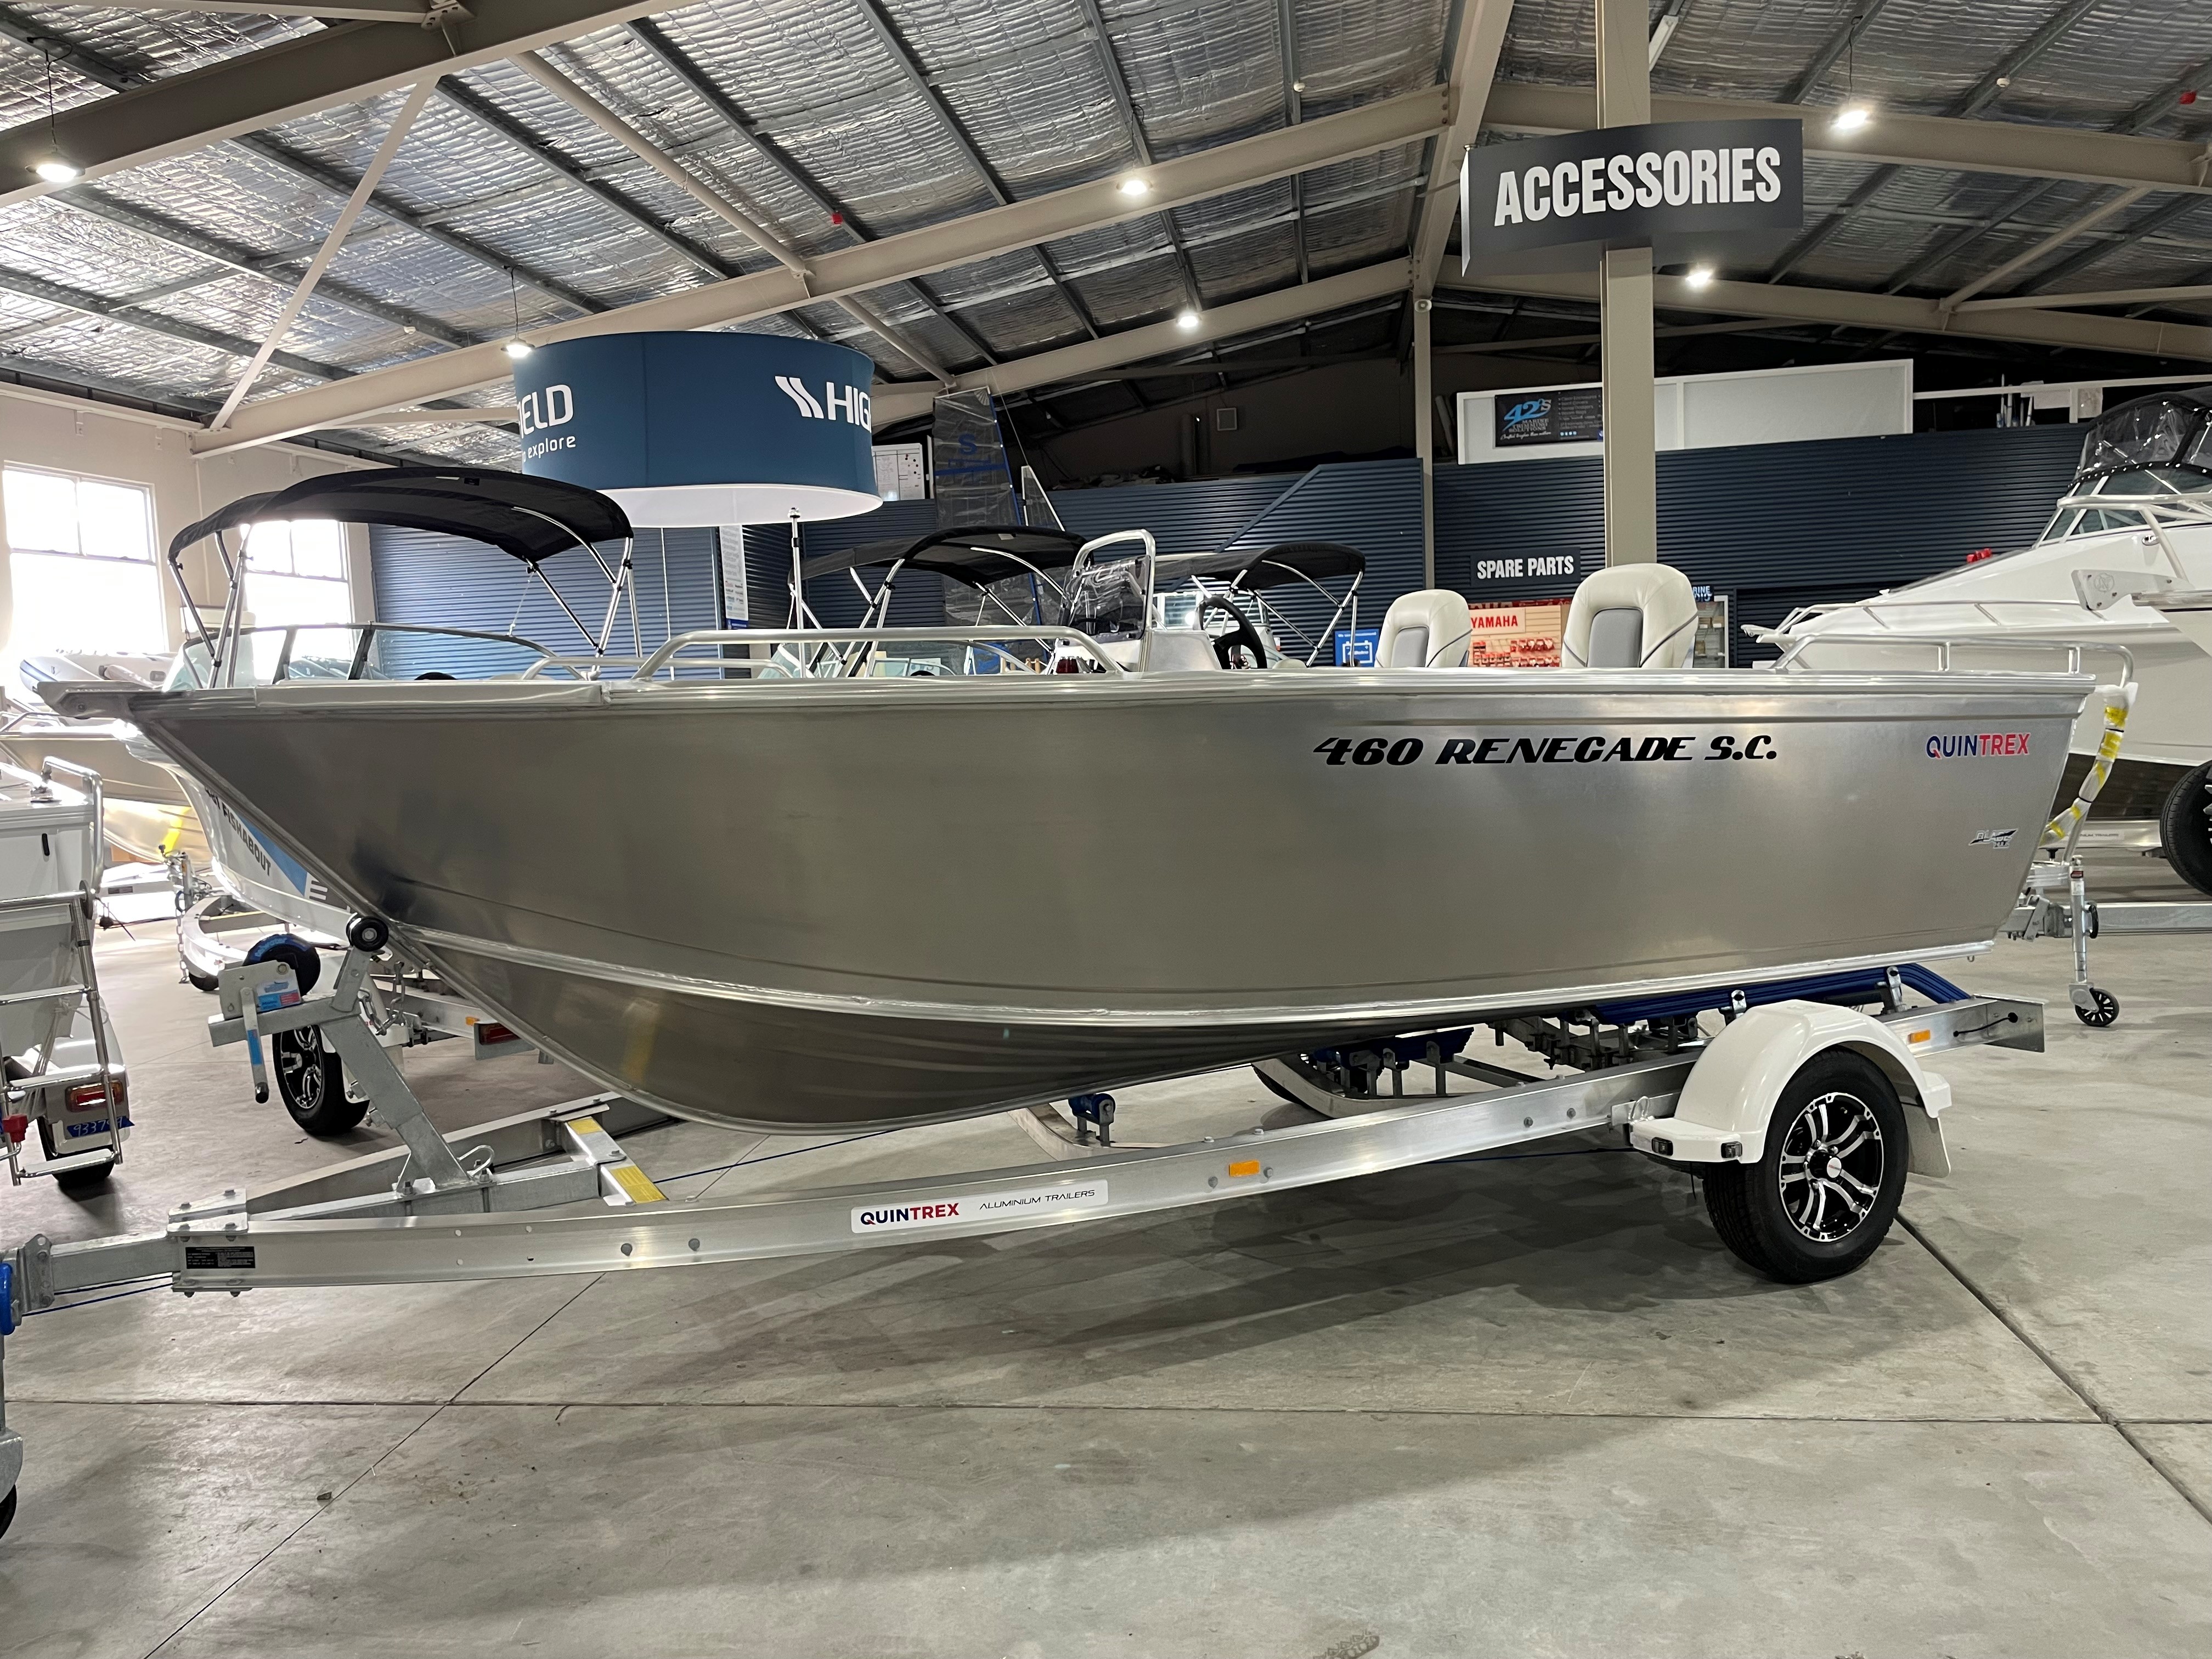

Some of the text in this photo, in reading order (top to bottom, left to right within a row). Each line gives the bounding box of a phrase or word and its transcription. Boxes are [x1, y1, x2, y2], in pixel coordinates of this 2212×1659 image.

[1494, 146, 1781, 227] ACCESSORIES
[517, 385, 573, 439] IELD
[826, 381, 872, 433] HIG
[528, 436, 576, 459] explore
[1477, 555, 1574, 579] SPARE PARTS
[1471, 615, 1518, 629] YAMAHA
[1313, 735, 1777, 766] 460 RENEGADE S.C.
[1926, 733, 2030, 759] QUINTREX
[222, 802, 272, 877] FISHABOUT
[860, 1189, 1095, 1225] QUINTREX ALUMINIUM TRAILERS
